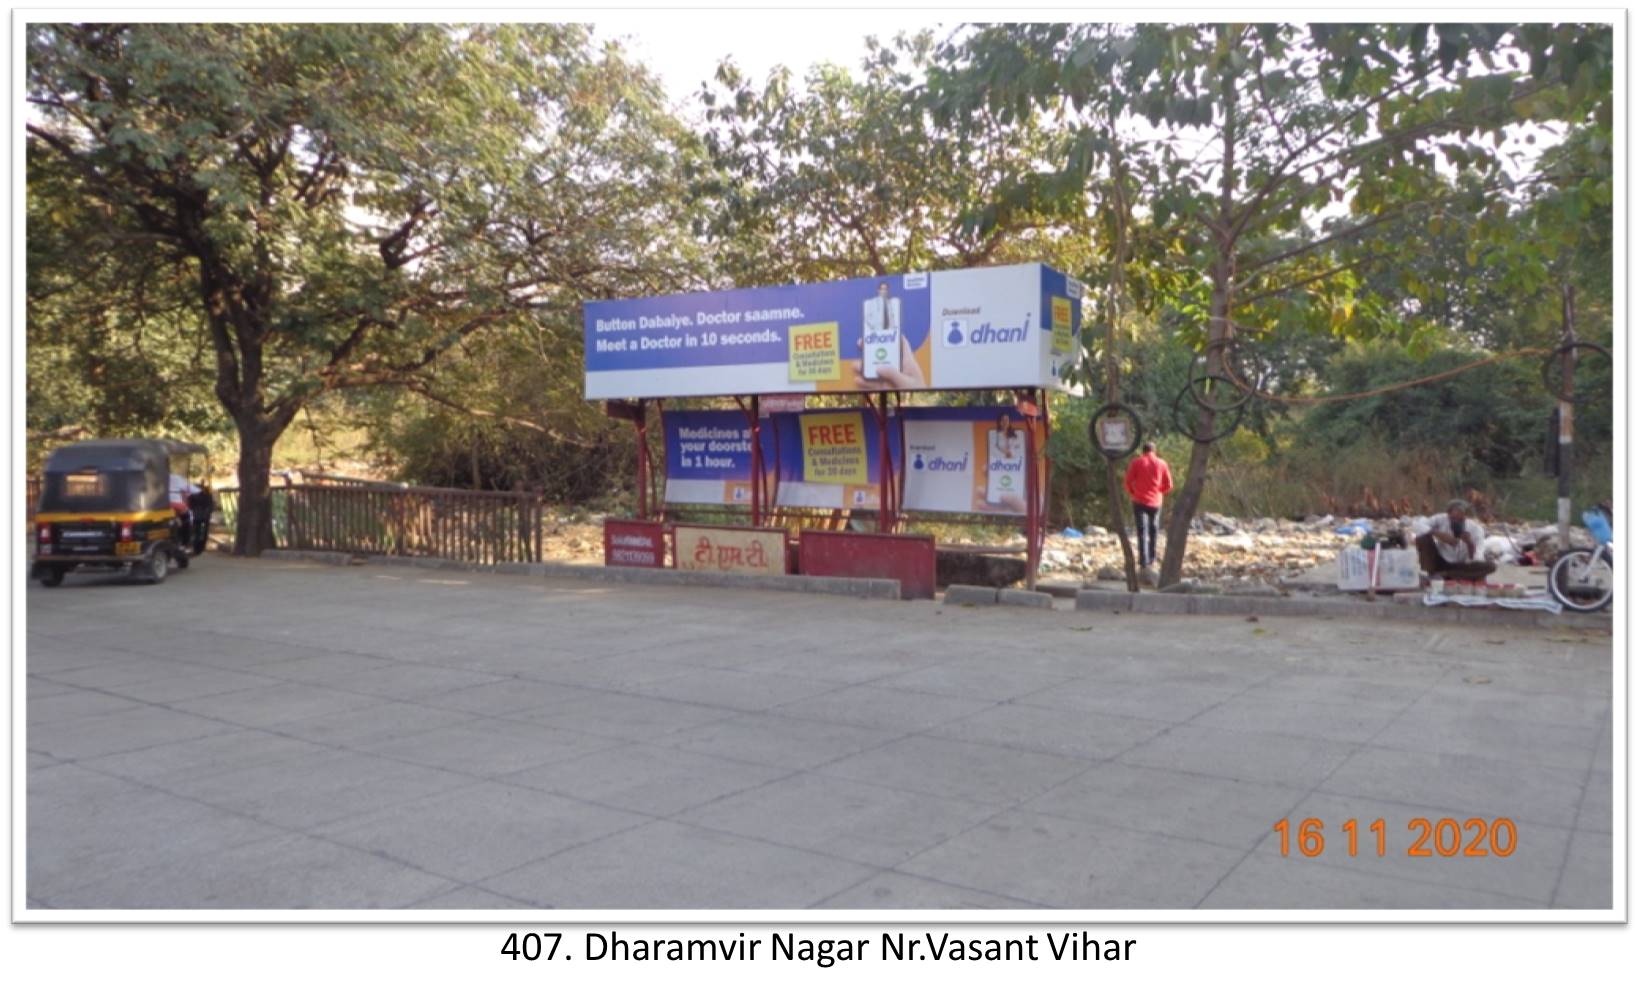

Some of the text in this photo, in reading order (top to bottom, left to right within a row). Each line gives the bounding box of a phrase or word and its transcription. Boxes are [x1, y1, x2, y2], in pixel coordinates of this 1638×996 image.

[597, 307, 805, 332] Button Dabaiye. Doctor saamne.
[970, 312, 1031, 344] dhani
[597, 328, 782, 352] Meet a Doctor in 10 seconds.
[794, 331, 832, 351] FREE
[865, 330, 898, 345] dhani
[679, 427, 739, 439] Medicines
[808, 424, 857, 445] FREE
[681, 442, 705, 453] your
[681, 456, 735, 468] in 1 hour.
[928, 452, 968, 471] dhani
[990, 456, 1022, 471] dhani
